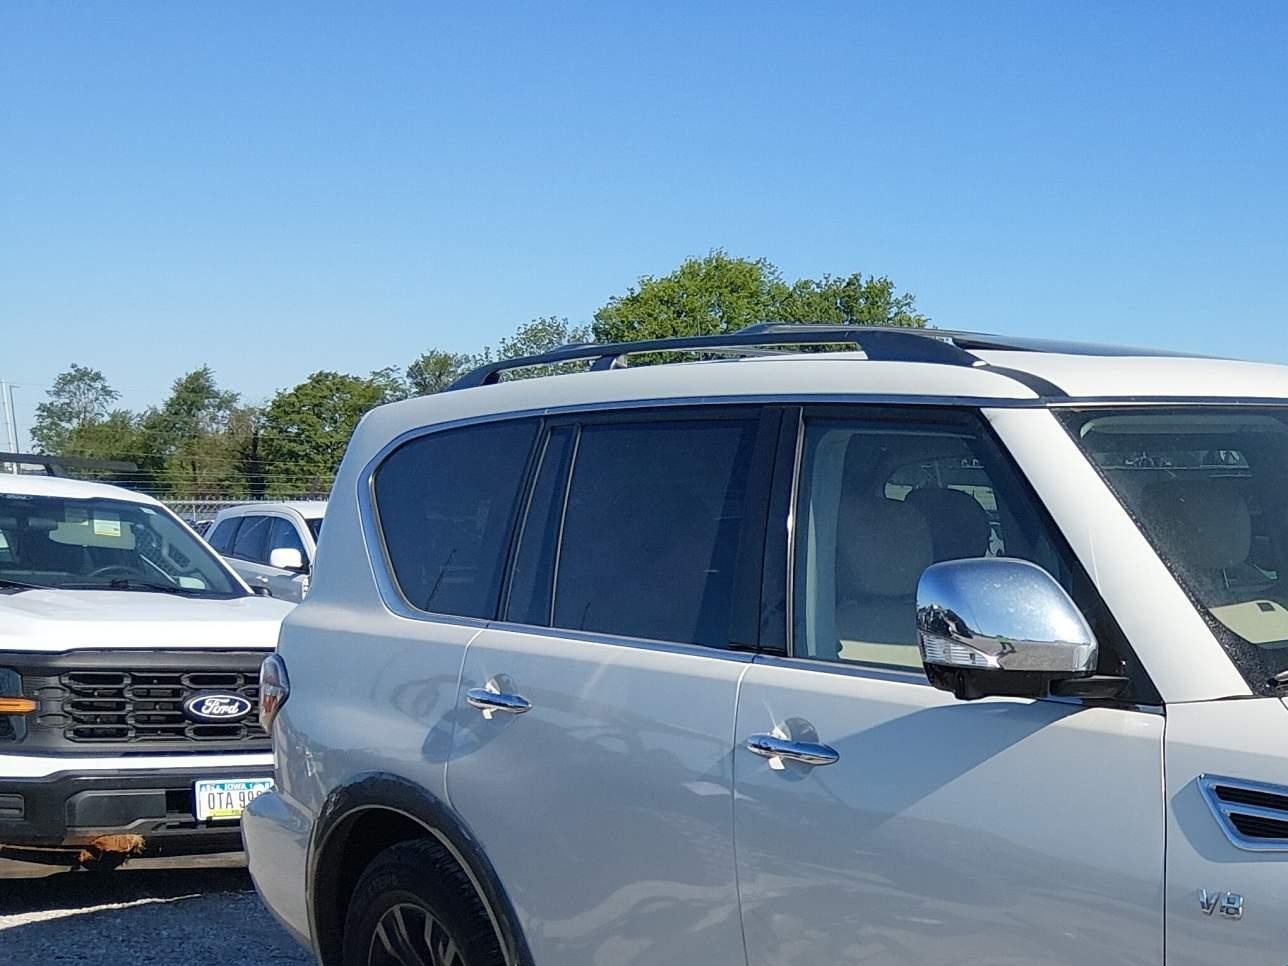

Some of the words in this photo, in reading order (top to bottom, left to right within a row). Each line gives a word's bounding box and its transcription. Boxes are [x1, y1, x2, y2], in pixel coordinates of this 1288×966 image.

[201, 698, 240, 715] Ford
[224, 783, 247, 792] IOWA
[207, 791, 234, 810] OTA
[1199, 887, 1244, 919] V8
